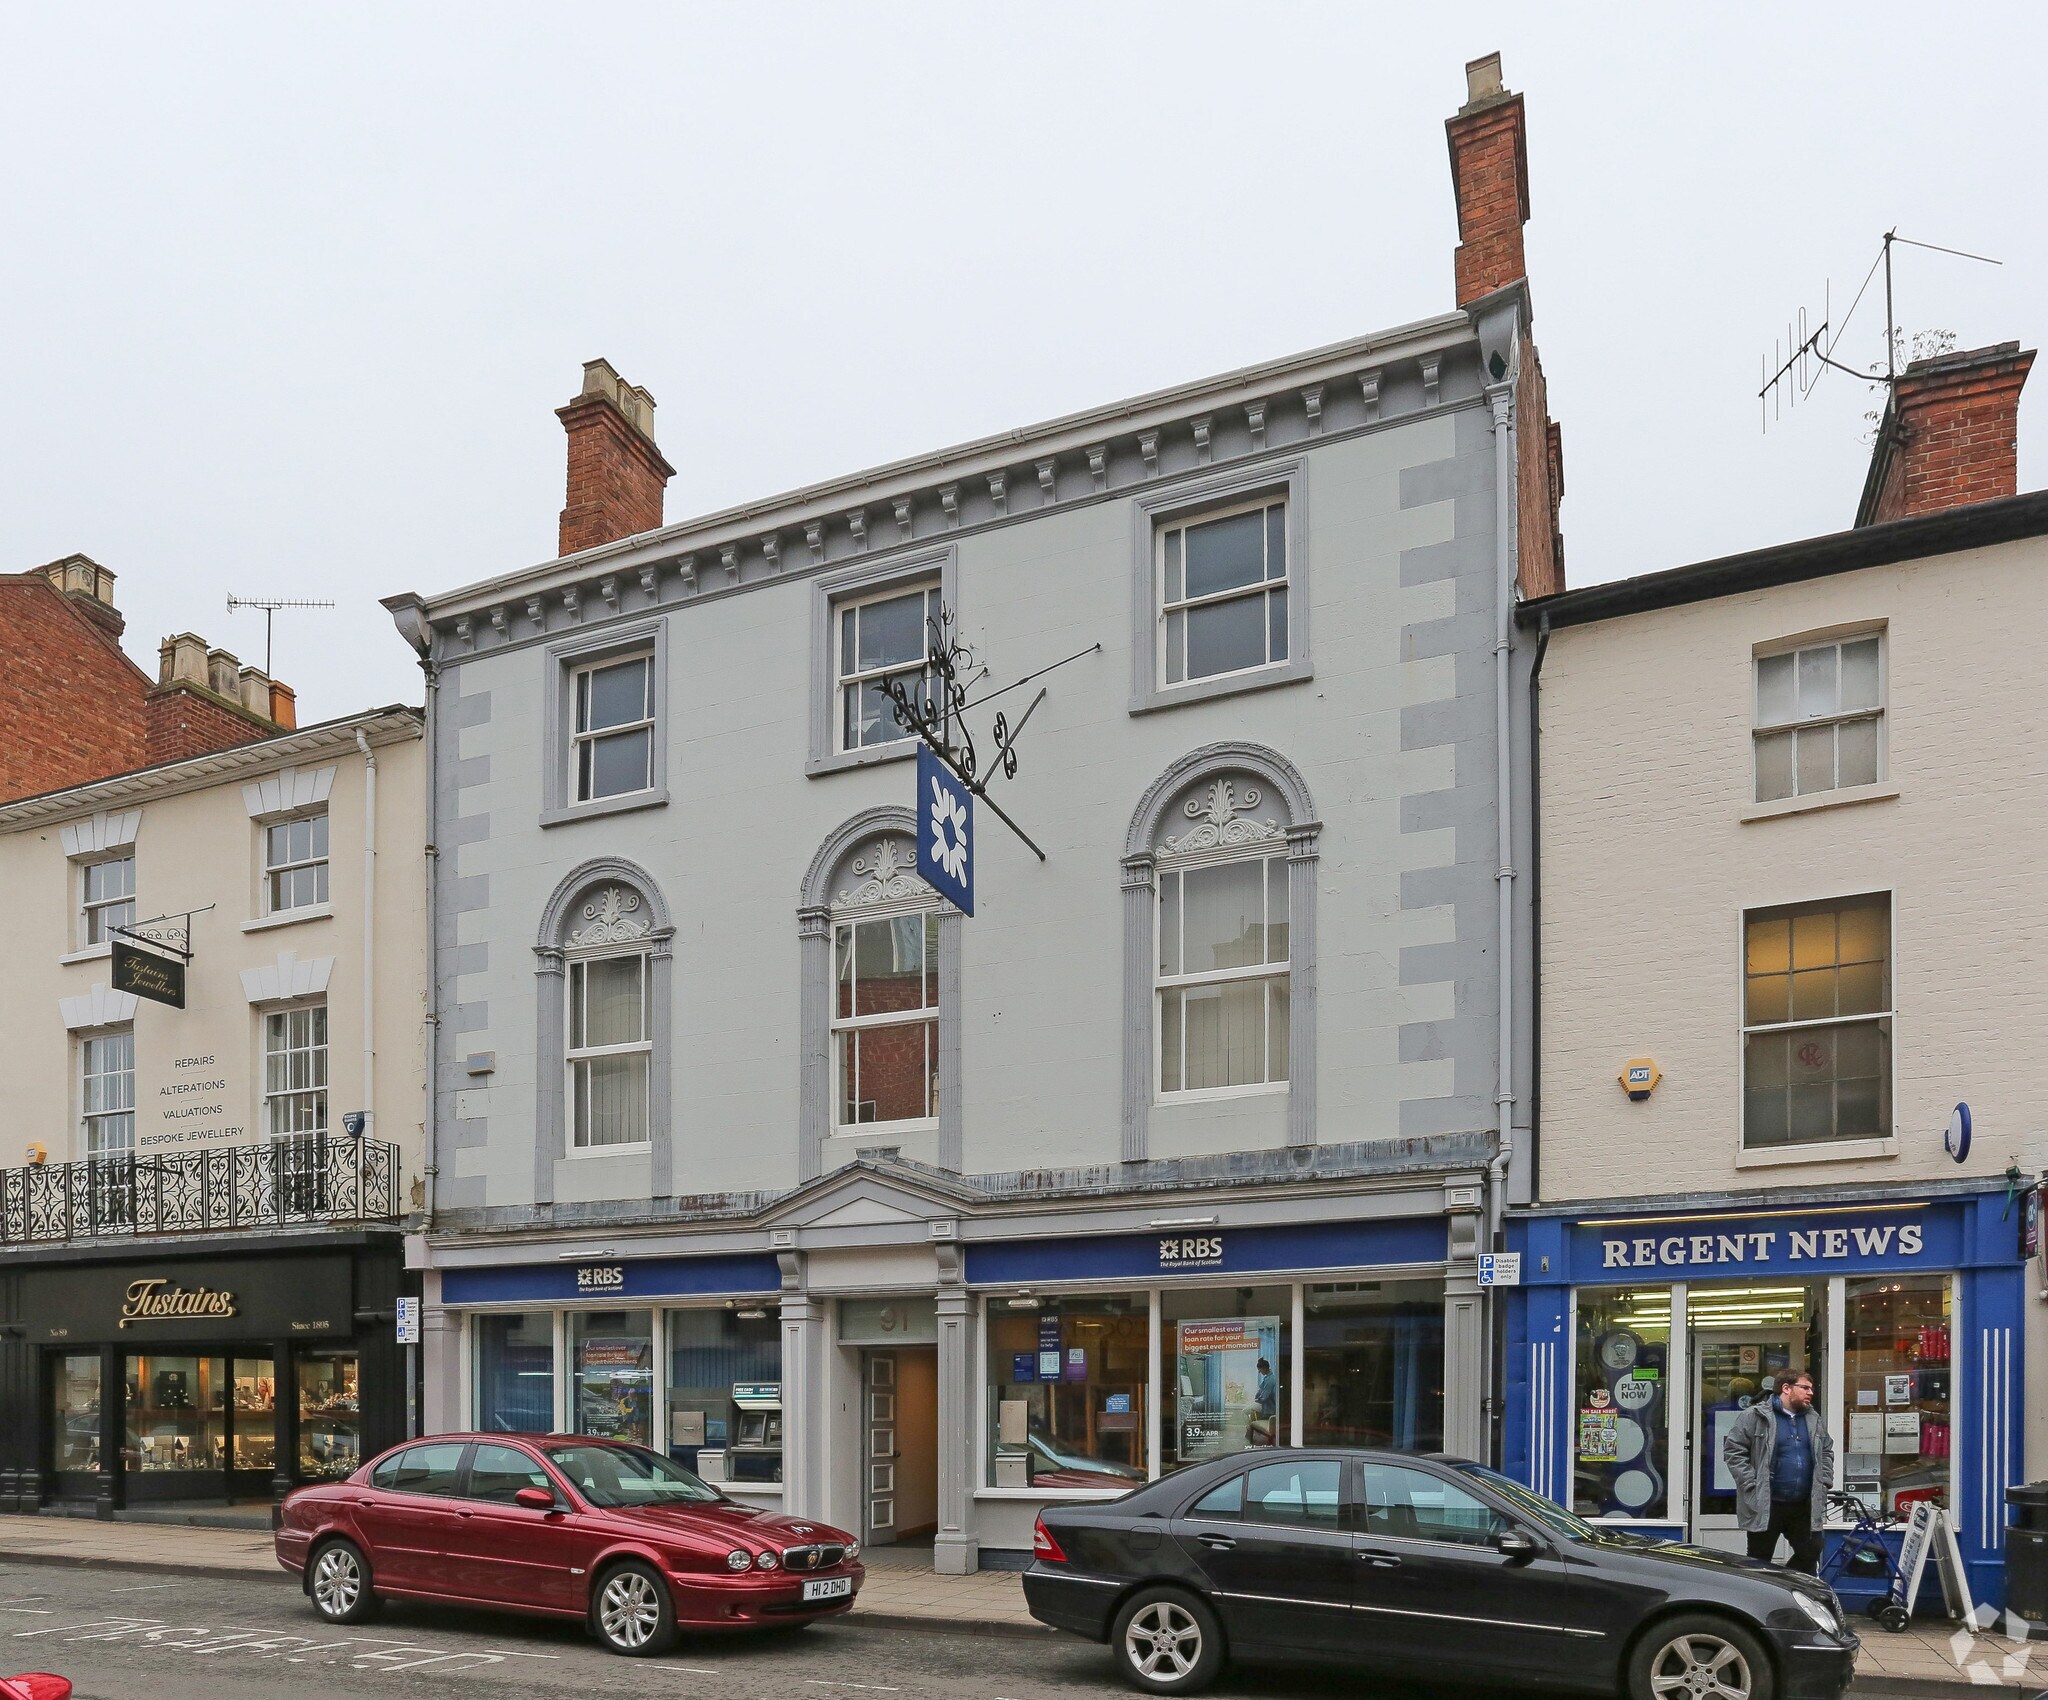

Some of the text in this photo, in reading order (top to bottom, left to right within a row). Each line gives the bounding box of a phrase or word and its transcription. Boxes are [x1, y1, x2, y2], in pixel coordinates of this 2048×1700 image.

[125, 956, 168, 980] Tustains
[125, 972, 176, 996] Jewellers
[174, 1055, 215, 1068] REPAIRS
[1630, 1070, 1649, 1080] ADT
[159, 1079, 226, 1096] ALTERATIONS
[163, 1104, 223, 1119] VALUATIONS
[140, 1126, 244, 1146] BESPOKE JEWELLERY
[1182, 1237, 1223, 1258] RBS
[1602, 1225, 1923, 1268] REGENT NEWS
[1169, 1260, 1182, 1268] Royal
[1195, 1259, 1201, 1267] of
[1201, 1258, 1222, 1266] Scotland
[593, 1267, 624, 1285] RBS
[122, 1279, 231, 1316] Tustains
[1184, 1327, 1198, 1335] Our
[1198, 1325, 1226, 1334] smallest
[1225, 1334, 1241, 1342] your
[1184, 1344, 1209, 1353] biggest
[1225, 1342, 1258, 1350] moments
[1621, 1383, 1647, 1391] PLAY
[1621, 1391, 1647, 1399] NOW
[823, 1582, 829, 1595] 2
[830, 1579, 846, 1594] DHD
[13, 1622, 506, 1672] DISABLED
